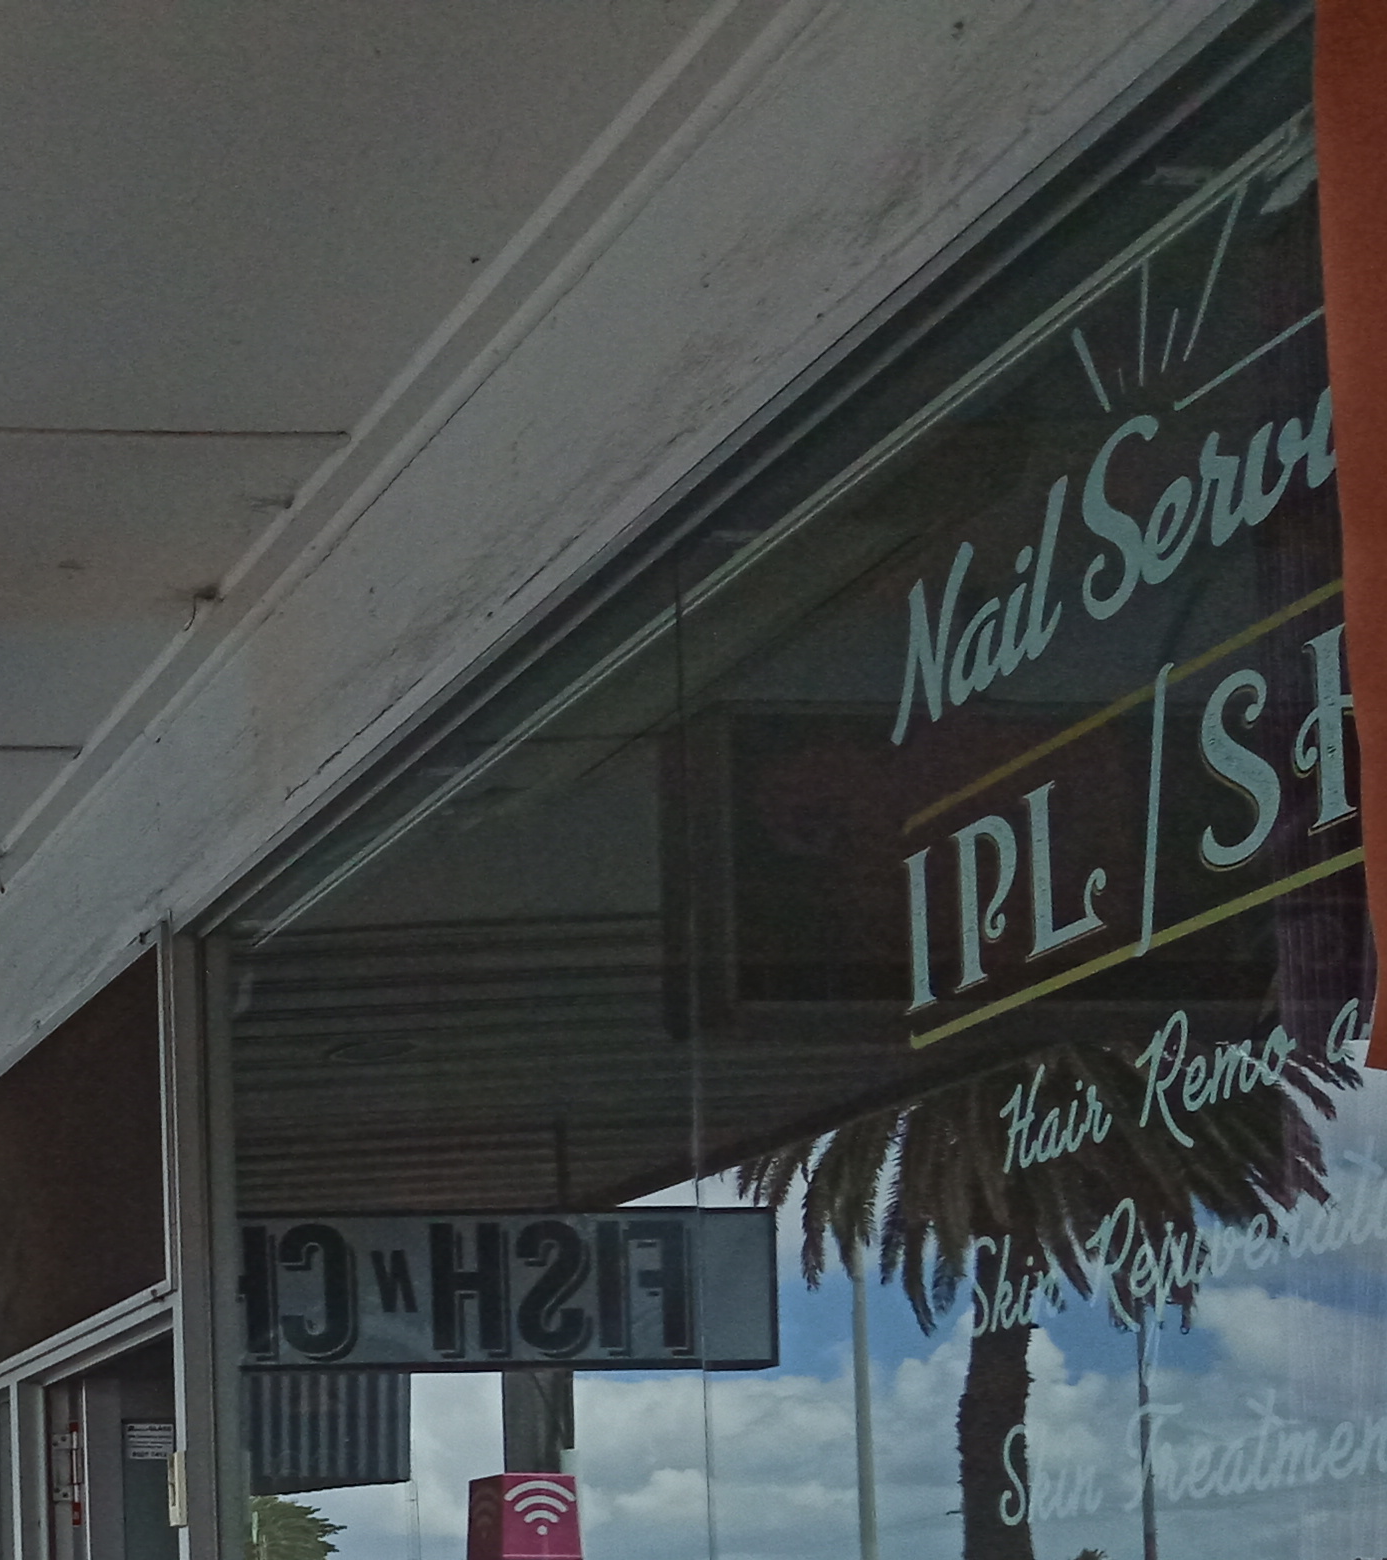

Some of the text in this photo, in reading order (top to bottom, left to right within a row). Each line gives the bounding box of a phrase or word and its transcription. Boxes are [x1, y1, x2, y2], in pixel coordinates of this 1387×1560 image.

[890, 474, 1068, 746] Nail
[999, 1064, 1113, 1174] Hair
[970, 1233, 1059, 1338] Skin
